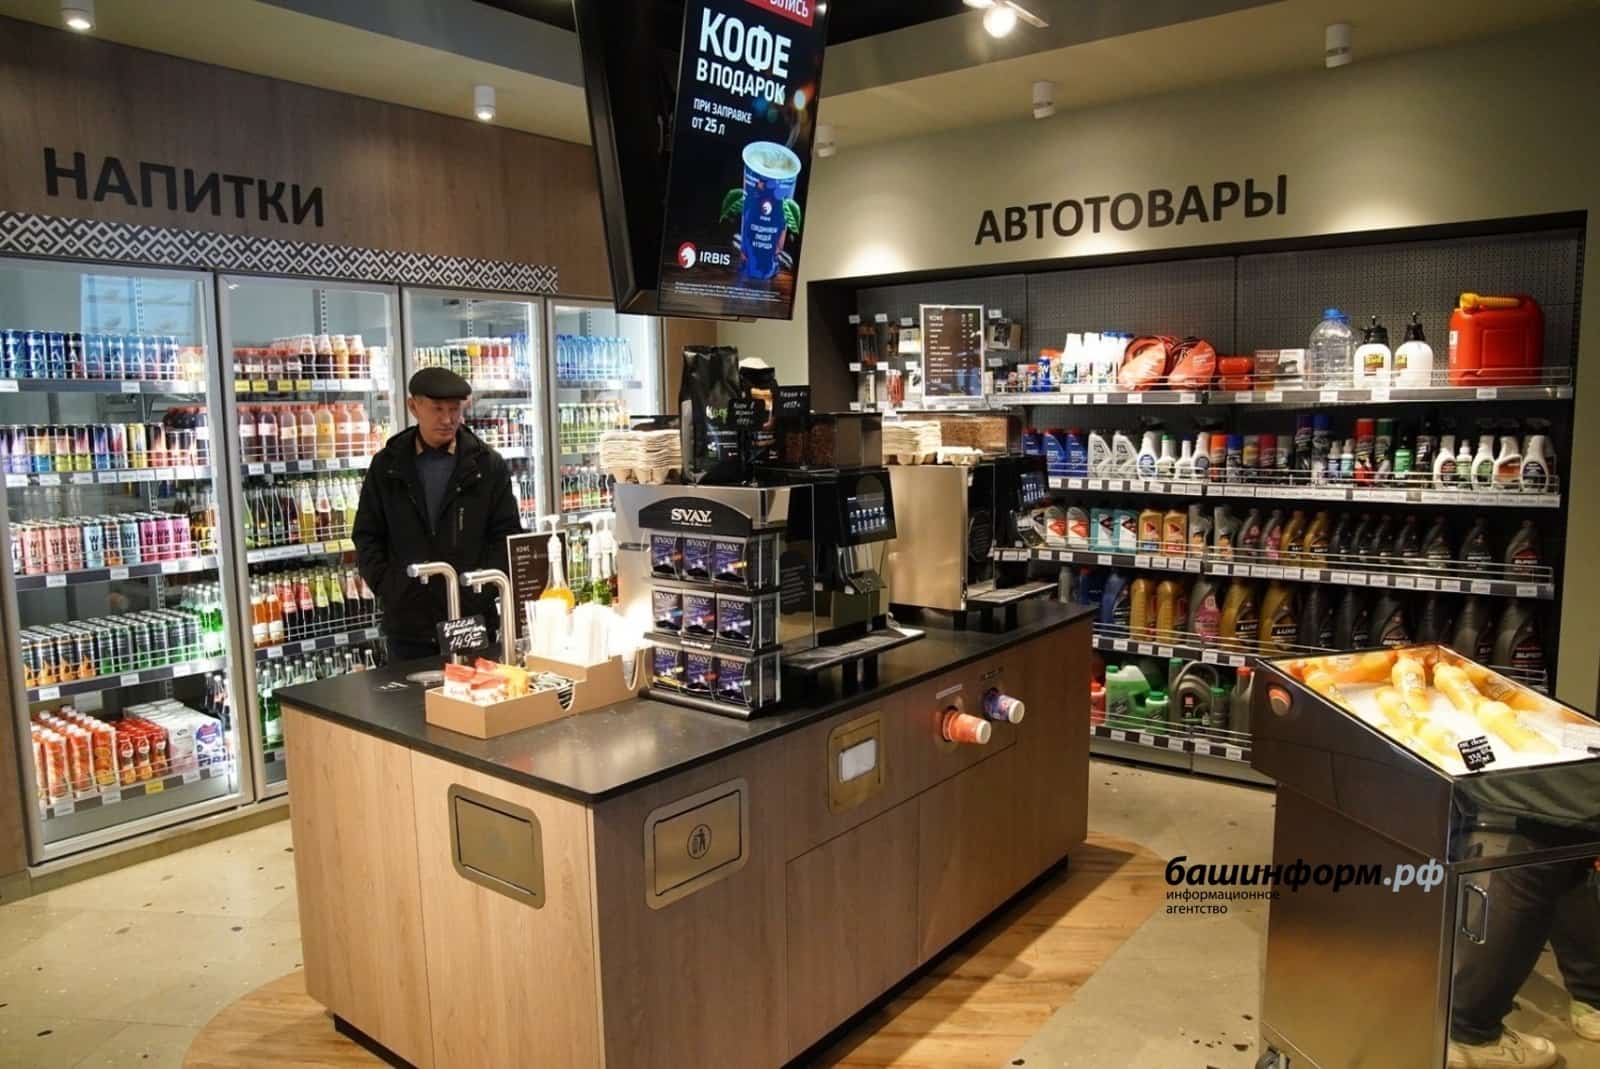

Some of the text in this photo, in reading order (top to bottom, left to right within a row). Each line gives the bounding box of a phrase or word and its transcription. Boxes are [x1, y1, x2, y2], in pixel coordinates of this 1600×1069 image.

[699, 7, 792, 79] КОФЕ
[696, 57, 786, 106] В ПОДАРОК
[691, 116, 704, 129] ОТ
[704, 117, 717, 133] 25
[693, 97, 752, 124] ПРИ ЗАПРАВКЕ
[43, 147, 324, 227] НАПИТКИ
[974, 174, 1288, 246] АВТОТОВАРЫ
[699, 250, 731, 266] IRBIS
